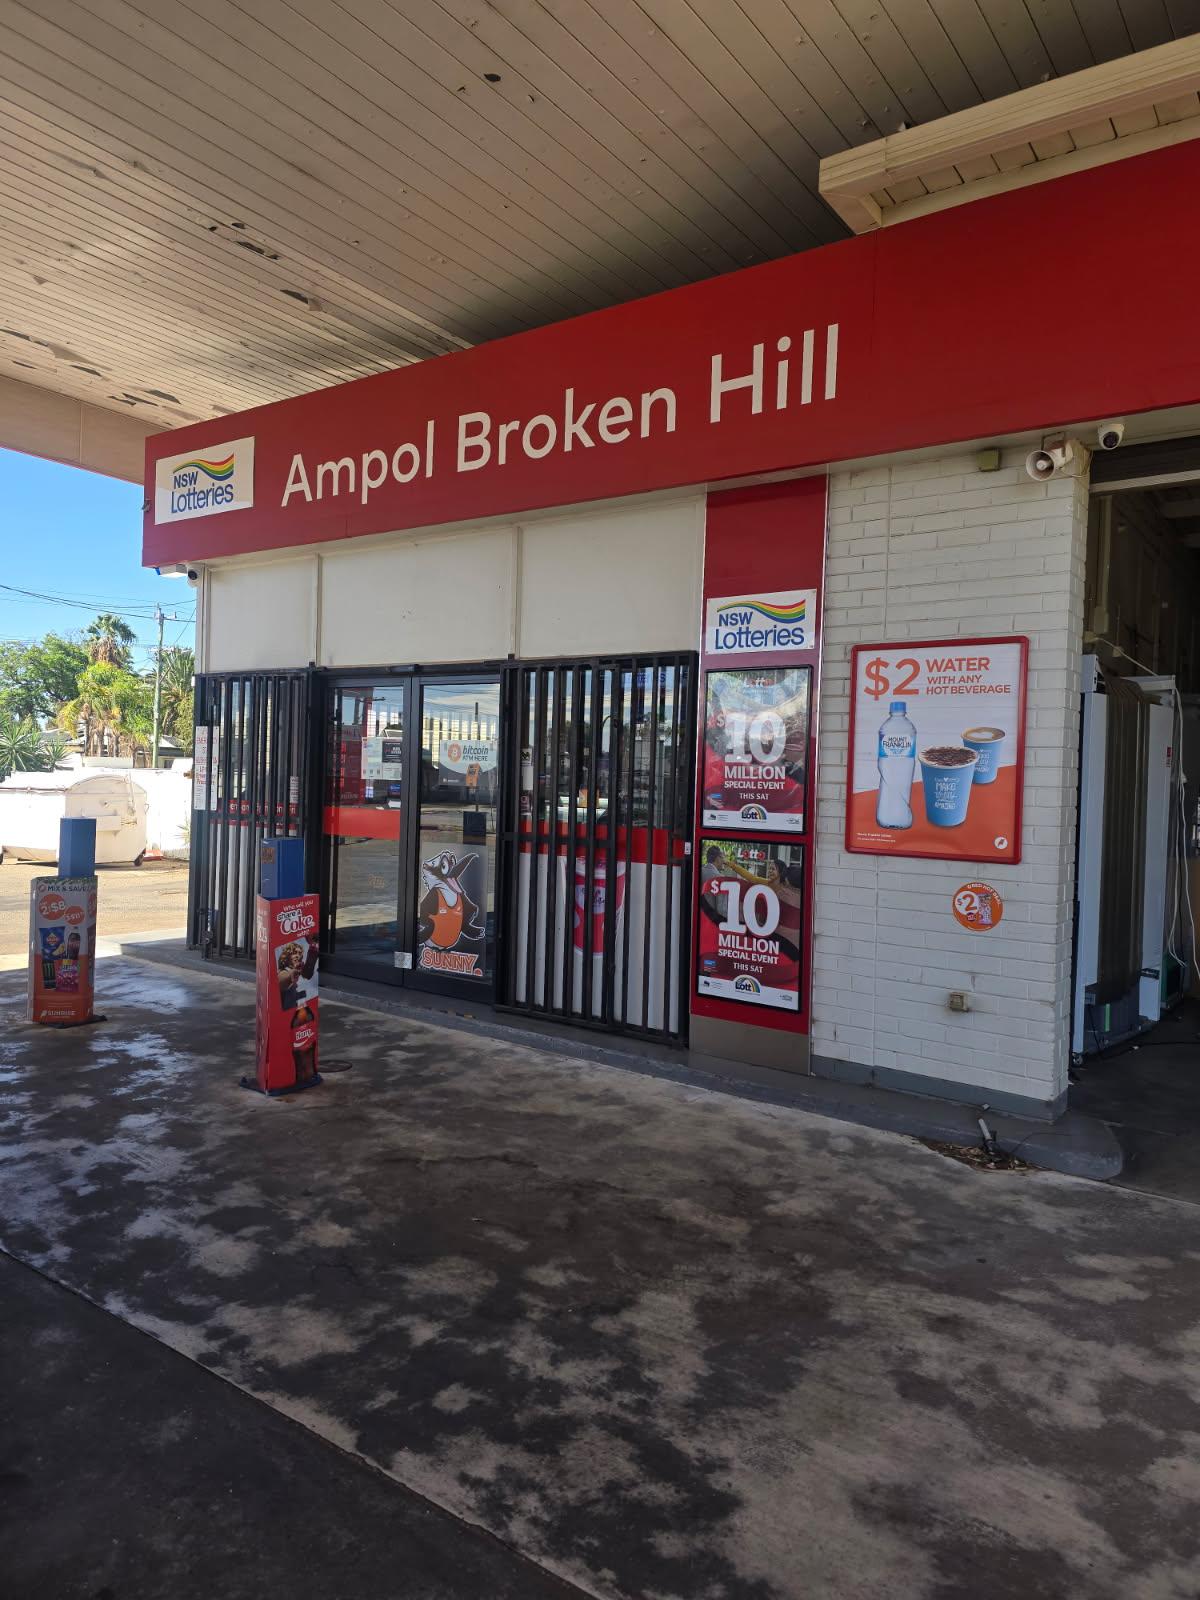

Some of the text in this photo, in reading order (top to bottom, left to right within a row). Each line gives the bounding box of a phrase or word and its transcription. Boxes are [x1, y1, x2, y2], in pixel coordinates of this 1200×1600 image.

[281, 323, 840, 506] Ampol Broken Hill
[172, 471, 199, 489] NSW
[170, 479, 234, 513] Lotteries
[718, 611, 754, 627] NSW
[715, 624, 805, 650] Lotteries
[926, 656, 991, 672] WATER
[863, 656, 921, 701] $2
[927, 673, 983, 685] WITH ANY
[926, 684, 1011, 695] HOT BEVERAGE
[462, 745, 489, 755] bitcoin
[724, 765, 786, 780] MILLION
[723, 780, 785, 791] SPECIAL EVENT
[739, 792, 769, 801] THIS SAT
[737, 847, 766, 861] Lotto
[278, 911, 297, 921] share
[710, 879, 781, 937] $10
[281, 915, 313, 935] Coke
[718, 933, 780, 955] MILLION
[423, 948, 475, 974] SUNNY
[717, 948, 779, 965] SPECIAL EVENT
[733, 962, 764, 974] THIS SAT
